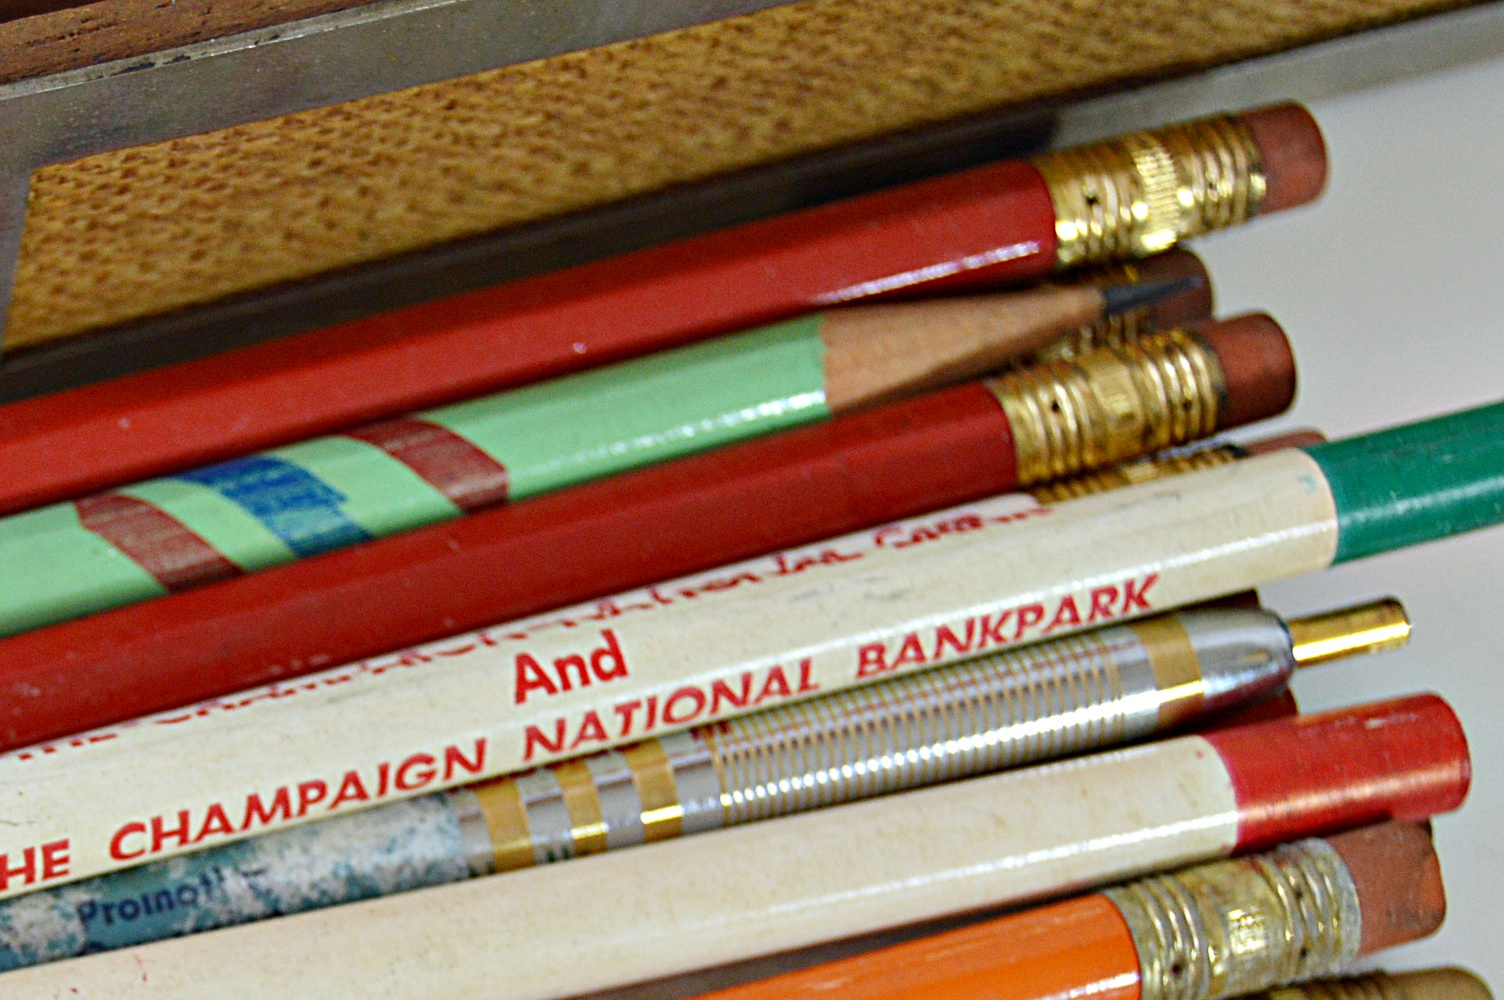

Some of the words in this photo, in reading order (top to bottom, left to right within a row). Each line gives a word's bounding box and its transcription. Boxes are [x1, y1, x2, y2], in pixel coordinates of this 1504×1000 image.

[108, 738, 488, 862] CHAMPAIGN
[523, 658, 821, 762] NATIONAL
[855, 573, 1159, 680] BANKPARK
[514, 629, 630, 705] And
